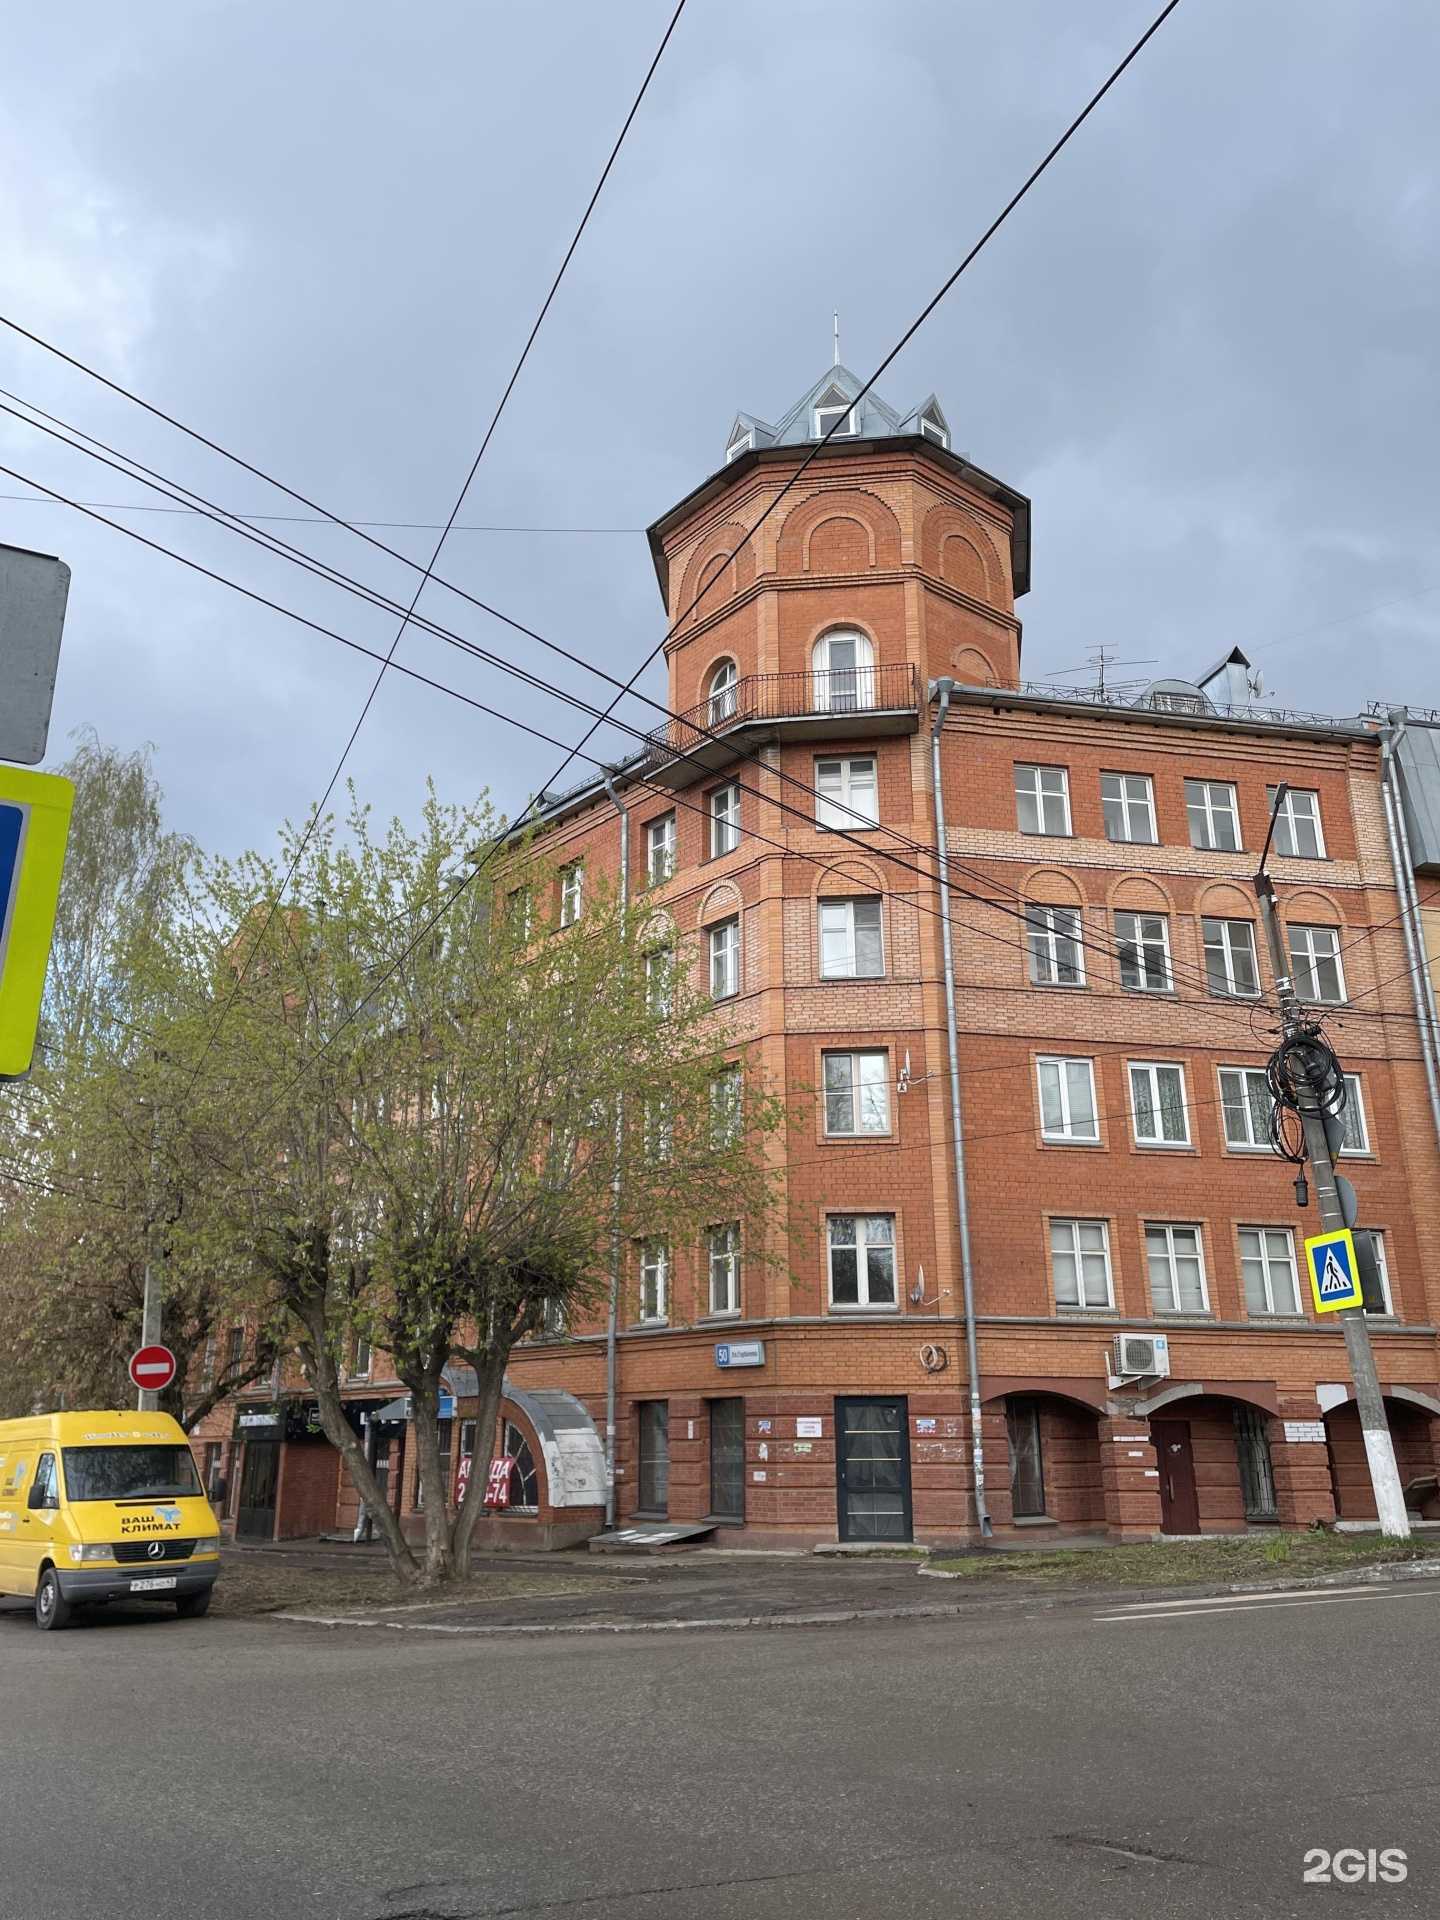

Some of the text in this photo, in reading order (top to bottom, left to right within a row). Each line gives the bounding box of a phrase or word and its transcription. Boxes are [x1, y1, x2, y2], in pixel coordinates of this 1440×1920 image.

[718, 1349, 728, 1362] 50
[458, 1459, 511, 1482] АДА
[121, 1516, 155, 1525] ВАШ
[121, 1523, 181, 1534] КЛИМАТ
